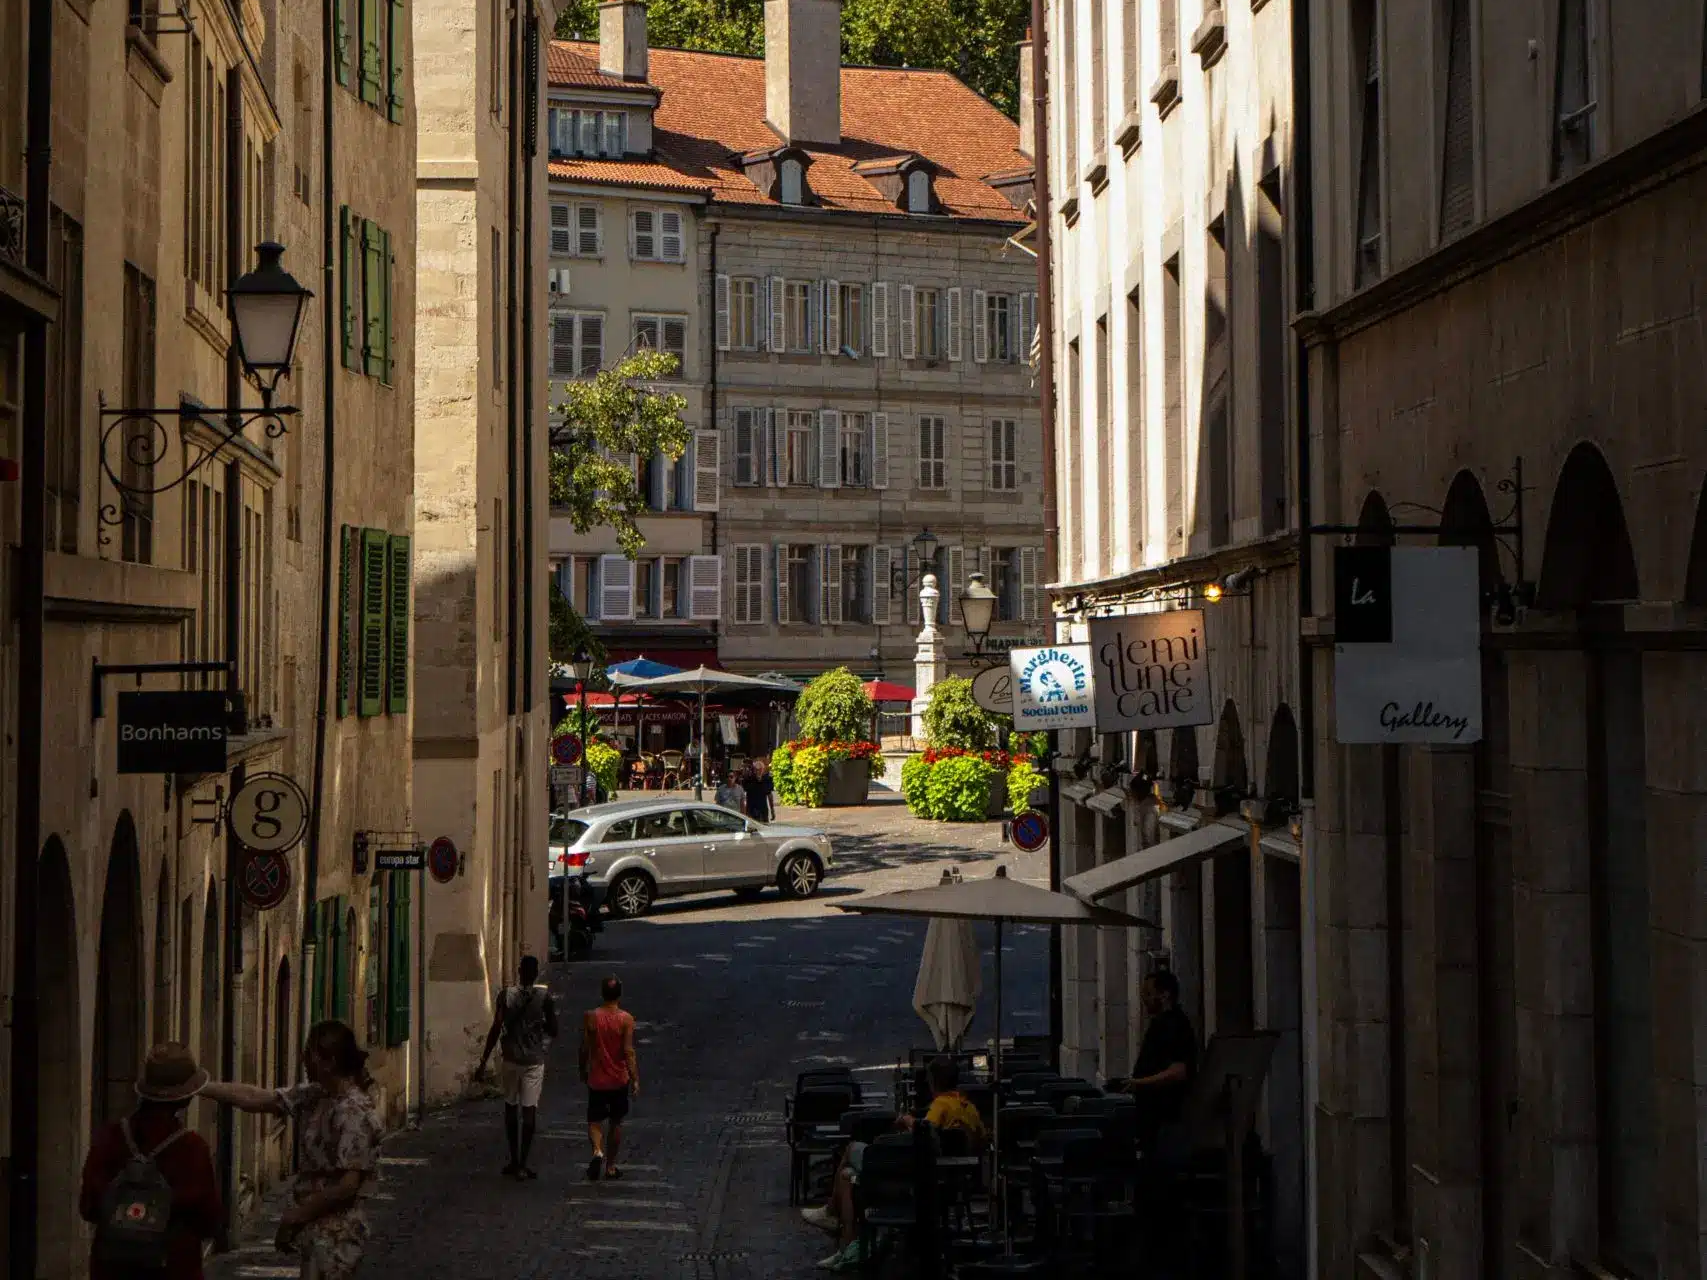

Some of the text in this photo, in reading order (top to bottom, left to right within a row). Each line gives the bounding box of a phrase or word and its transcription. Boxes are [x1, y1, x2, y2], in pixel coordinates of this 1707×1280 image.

[1351, 576, 1377, 606] La
[1100, 627, 1198, 667] demi
[1020, 648, 1086, 694] Margherita
[1109, 660, 1192, 696] lune
[120, 722, 223, 741] Bonhams
[1380, 701, 1468, 739] Gallery
[251, 789, 288, 839] g
[379, 853, 420, 868] europa star
